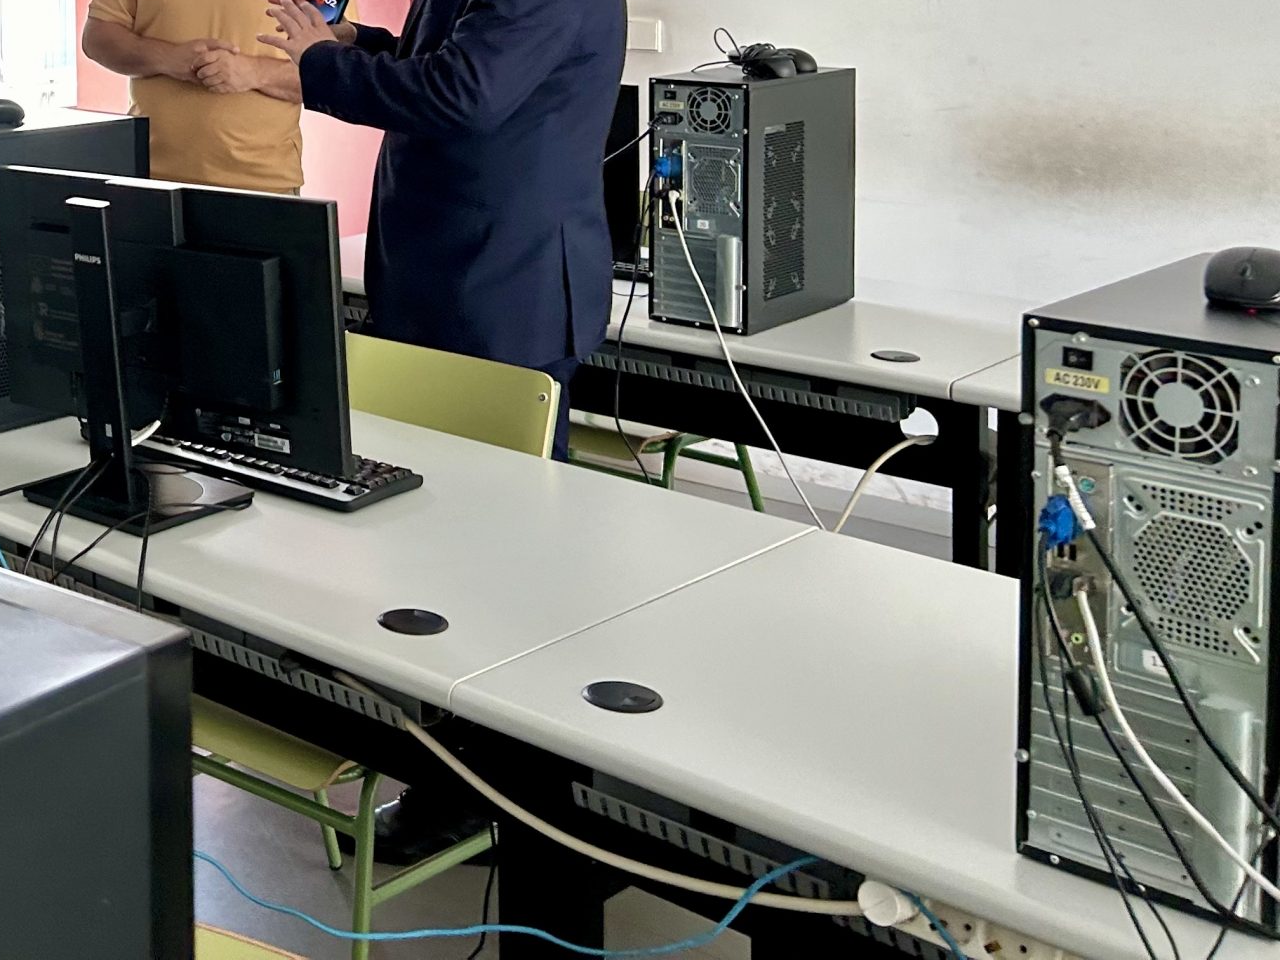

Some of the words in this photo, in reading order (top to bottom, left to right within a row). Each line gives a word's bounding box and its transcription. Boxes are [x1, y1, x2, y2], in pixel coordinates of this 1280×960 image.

[74, 252, 102, 265] PHILIPS
[1054, 371, 1071, 385] AC
[1072, 373, 1101, 390] 230V
